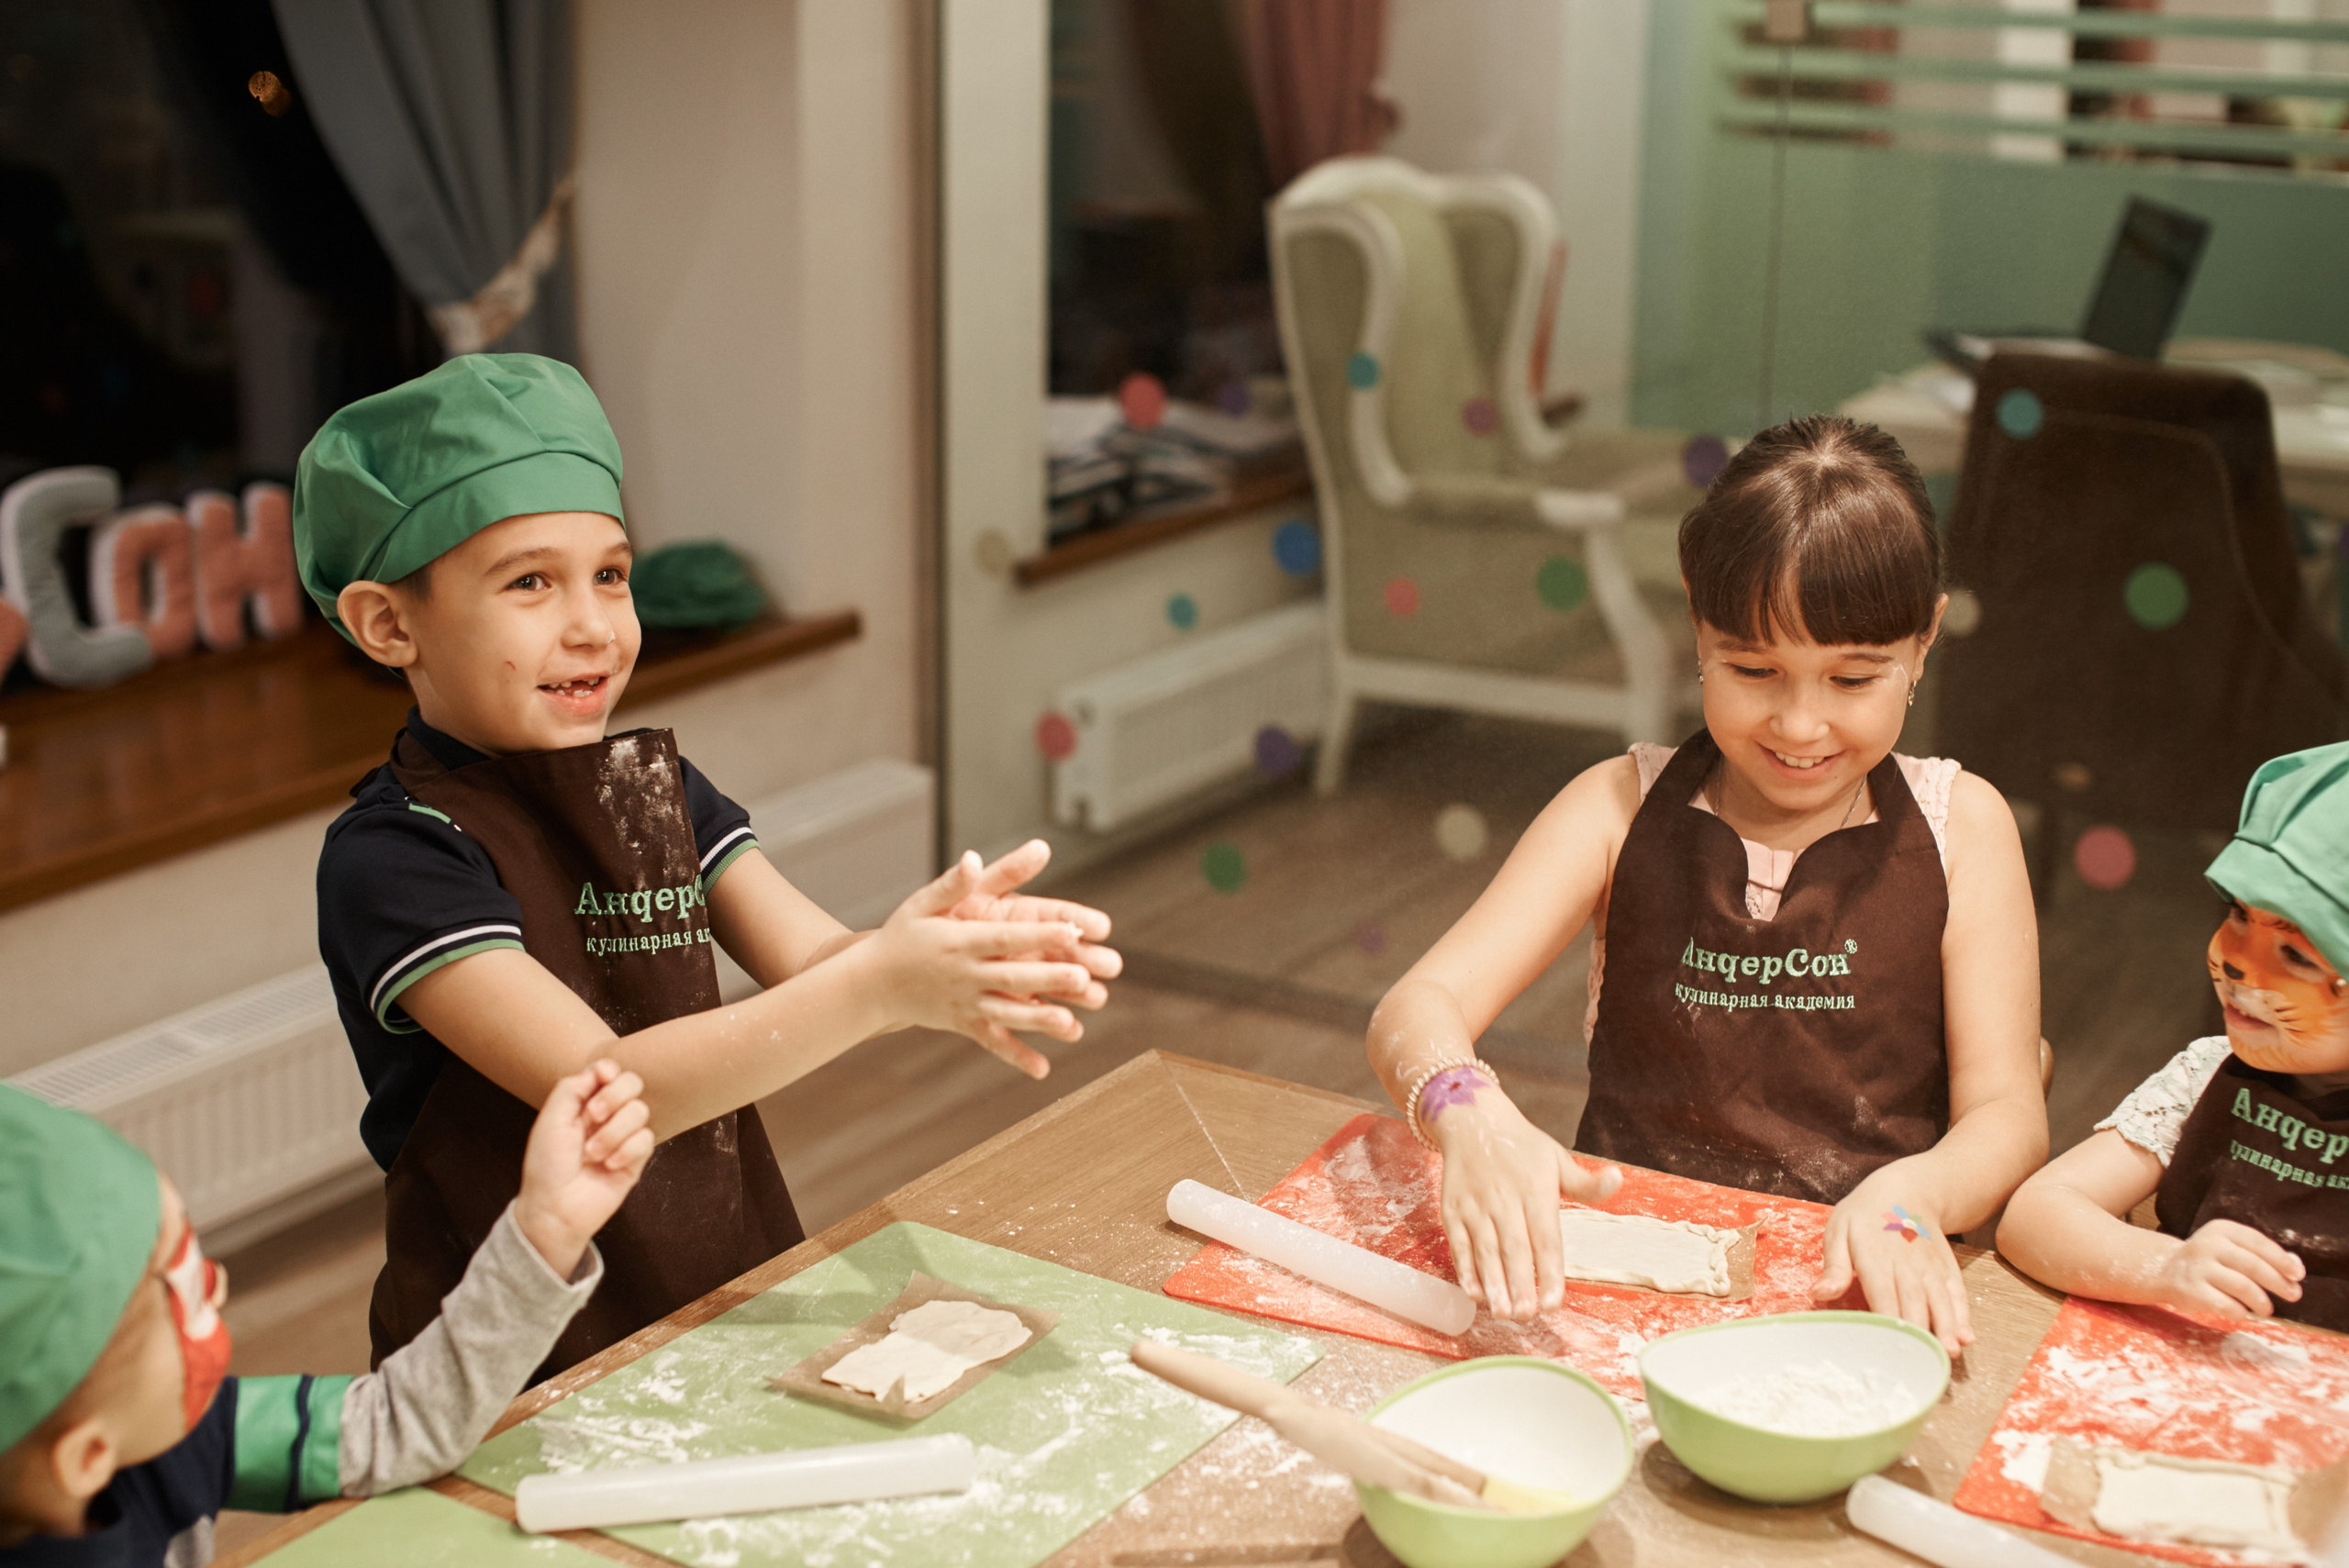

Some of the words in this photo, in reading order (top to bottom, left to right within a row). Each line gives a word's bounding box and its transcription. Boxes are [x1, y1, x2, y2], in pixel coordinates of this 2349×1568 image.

[0, 463, 304, 690] Сон
[586, 929, 693, 957] кулинарная
[1675, 983, 1768, 1013] кулинарная
[1775, 995, 1855, 1011] академия
[2230, 1139, 2326, 1187] улинарная
